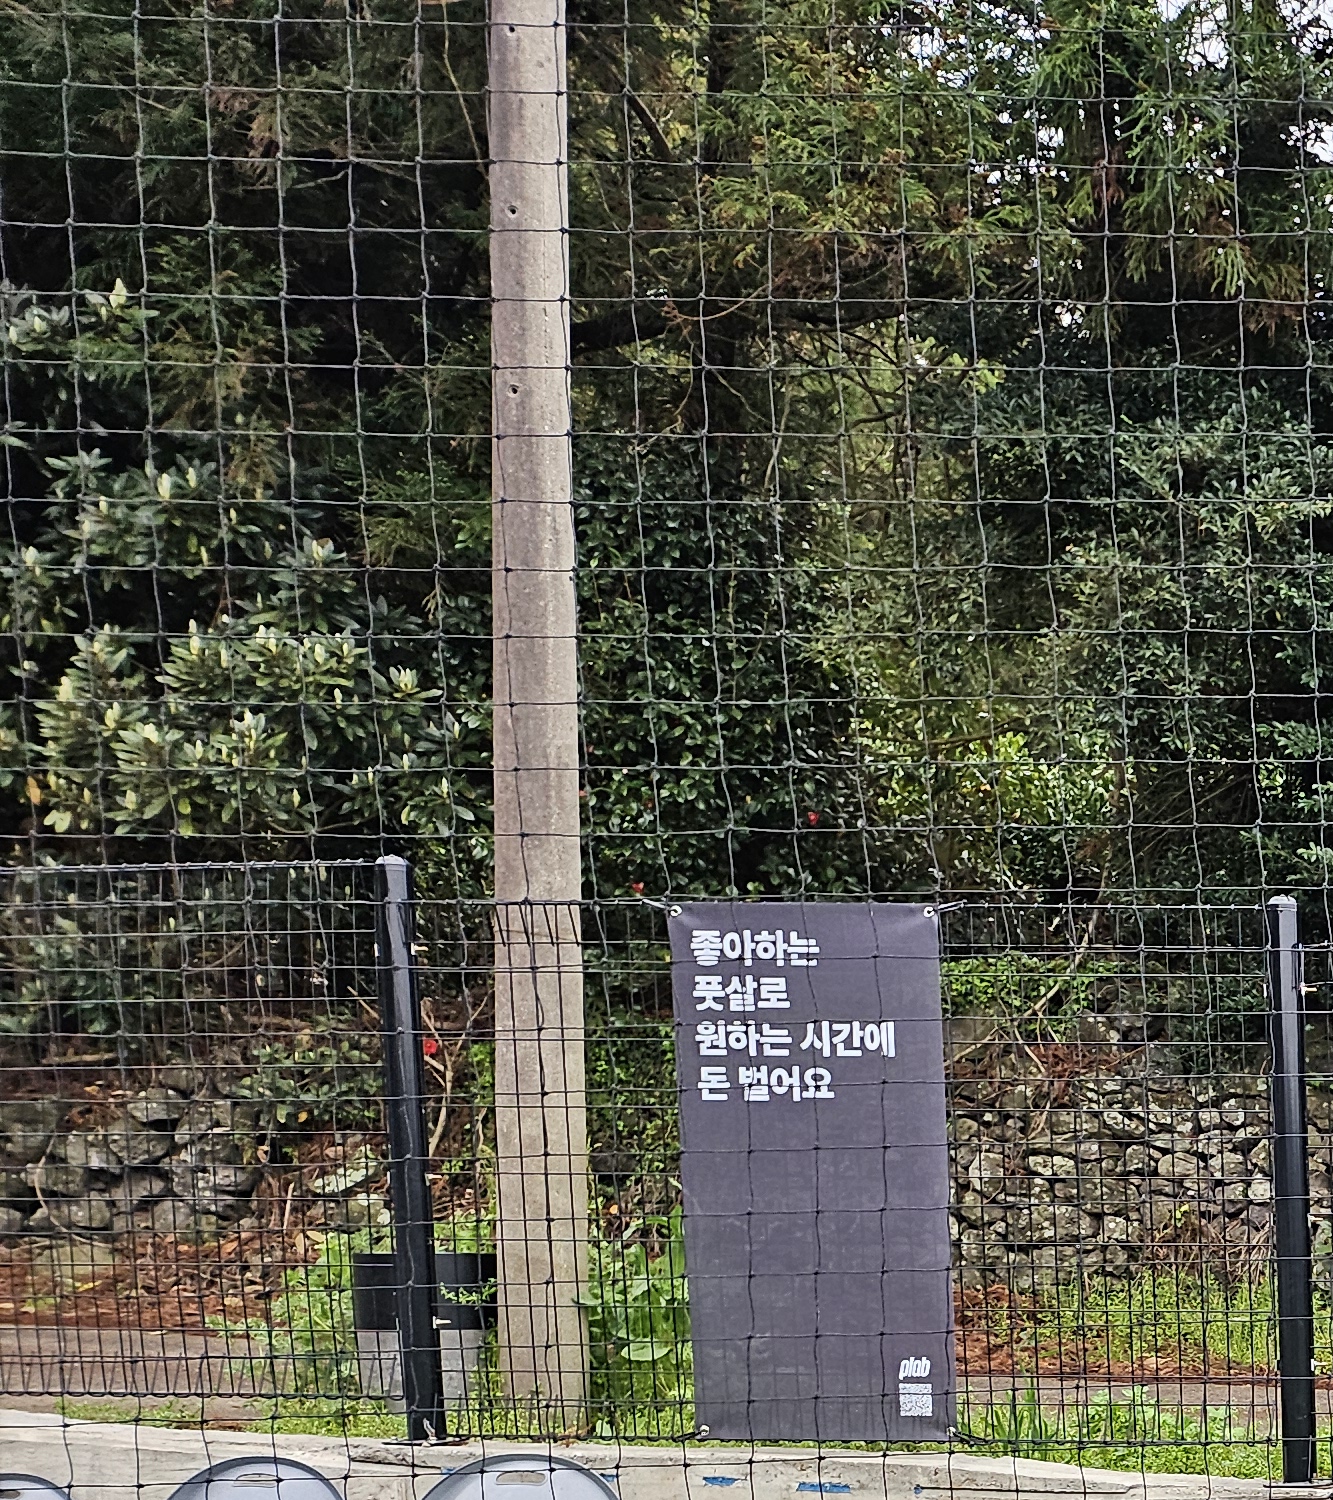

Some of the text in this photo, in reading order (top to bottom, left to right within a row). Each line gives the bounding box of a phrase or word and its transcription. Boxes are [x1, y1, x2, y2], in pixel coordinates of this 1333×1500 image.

[690, 929, 820, 967] 좋아하는
[692, 974, 791, 1012] 풋살로
[694, 1019, 896, 1058] 원하는 시간에
[697, 1065, 835, 1102] 돈 벌어요
[899, 1356, 931, 1381] plab
